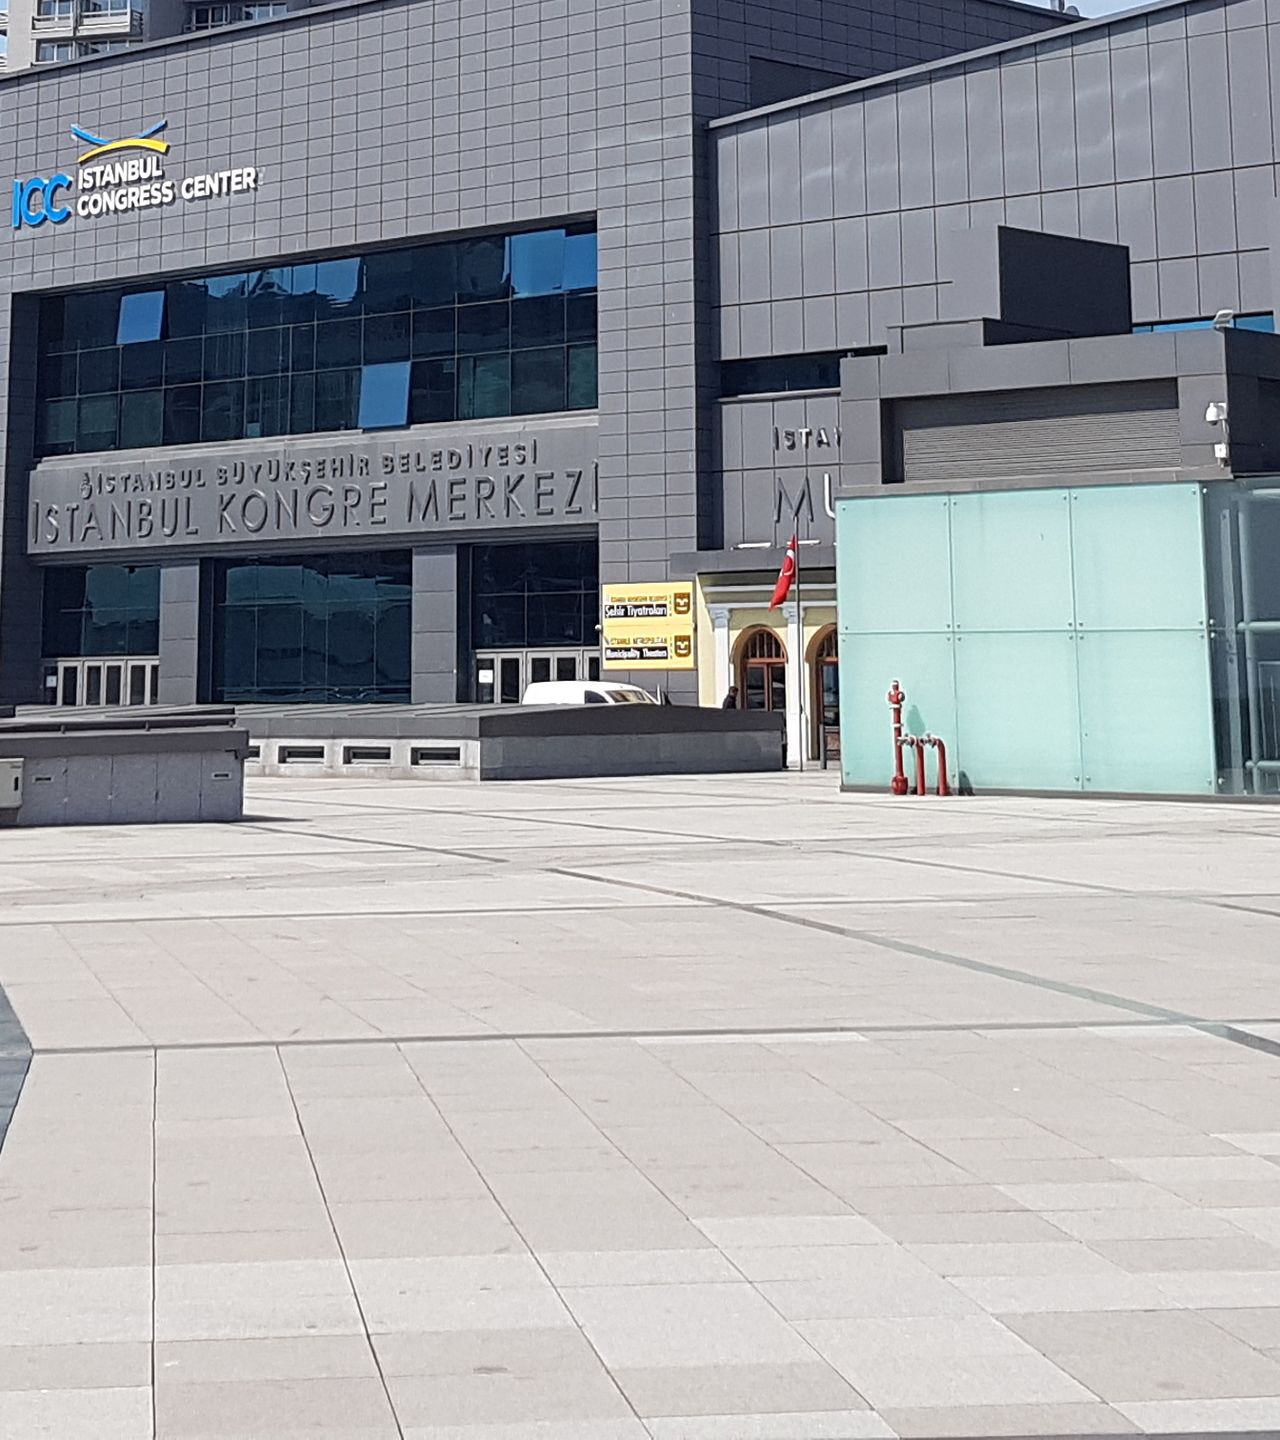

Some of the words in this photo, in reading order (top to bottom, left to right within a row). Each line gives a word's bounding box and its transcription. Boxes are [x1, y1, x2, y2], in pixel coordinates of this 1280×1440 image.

[77, 180, 175, 217] CONGRESS
[181, 166, 257, 200] CENTER
[78, 155, 163, 191] ISTANBUL
[12, 172, 73, 229] ICC
[218, 480, 388, 537] KONGRE
